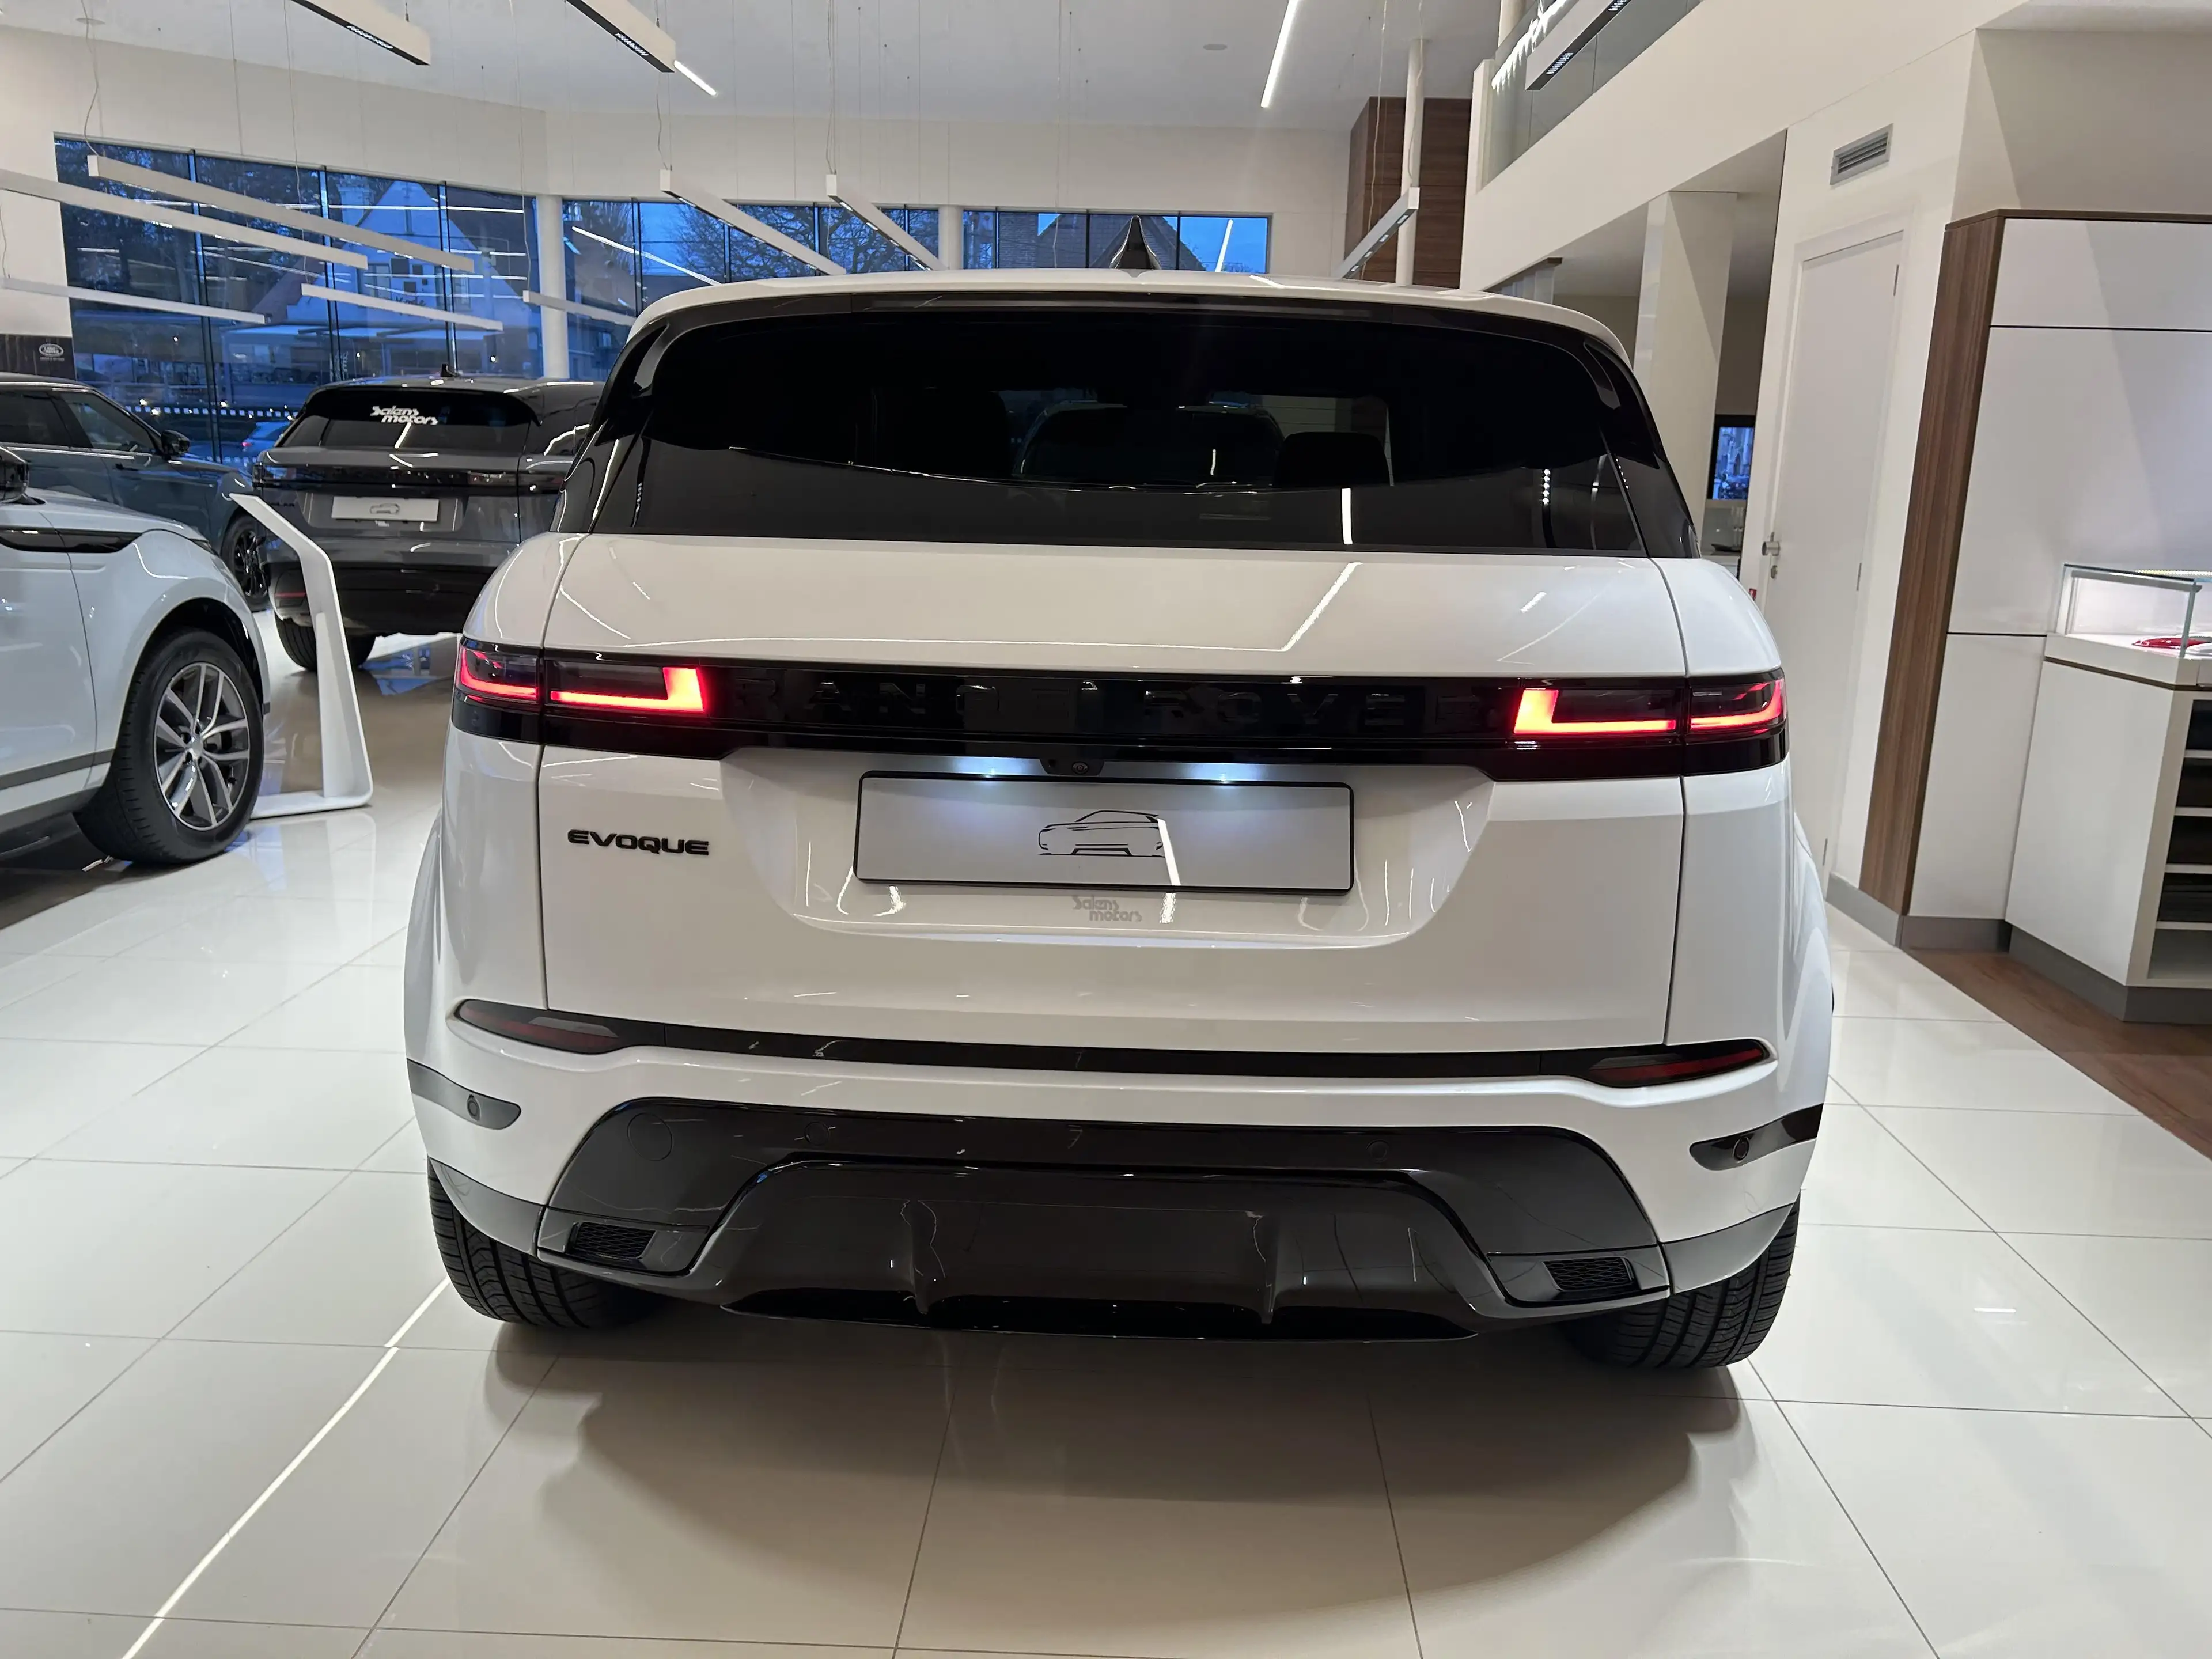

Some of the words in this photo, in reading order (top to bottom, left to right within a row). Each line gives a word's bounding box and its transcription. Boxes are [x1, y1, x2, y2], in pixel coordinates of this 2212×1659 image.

[381, 415, 438, 425] motors
[567, 829, 709, 855] EVOQUE
[1089, 910, 1142, 922] motors
